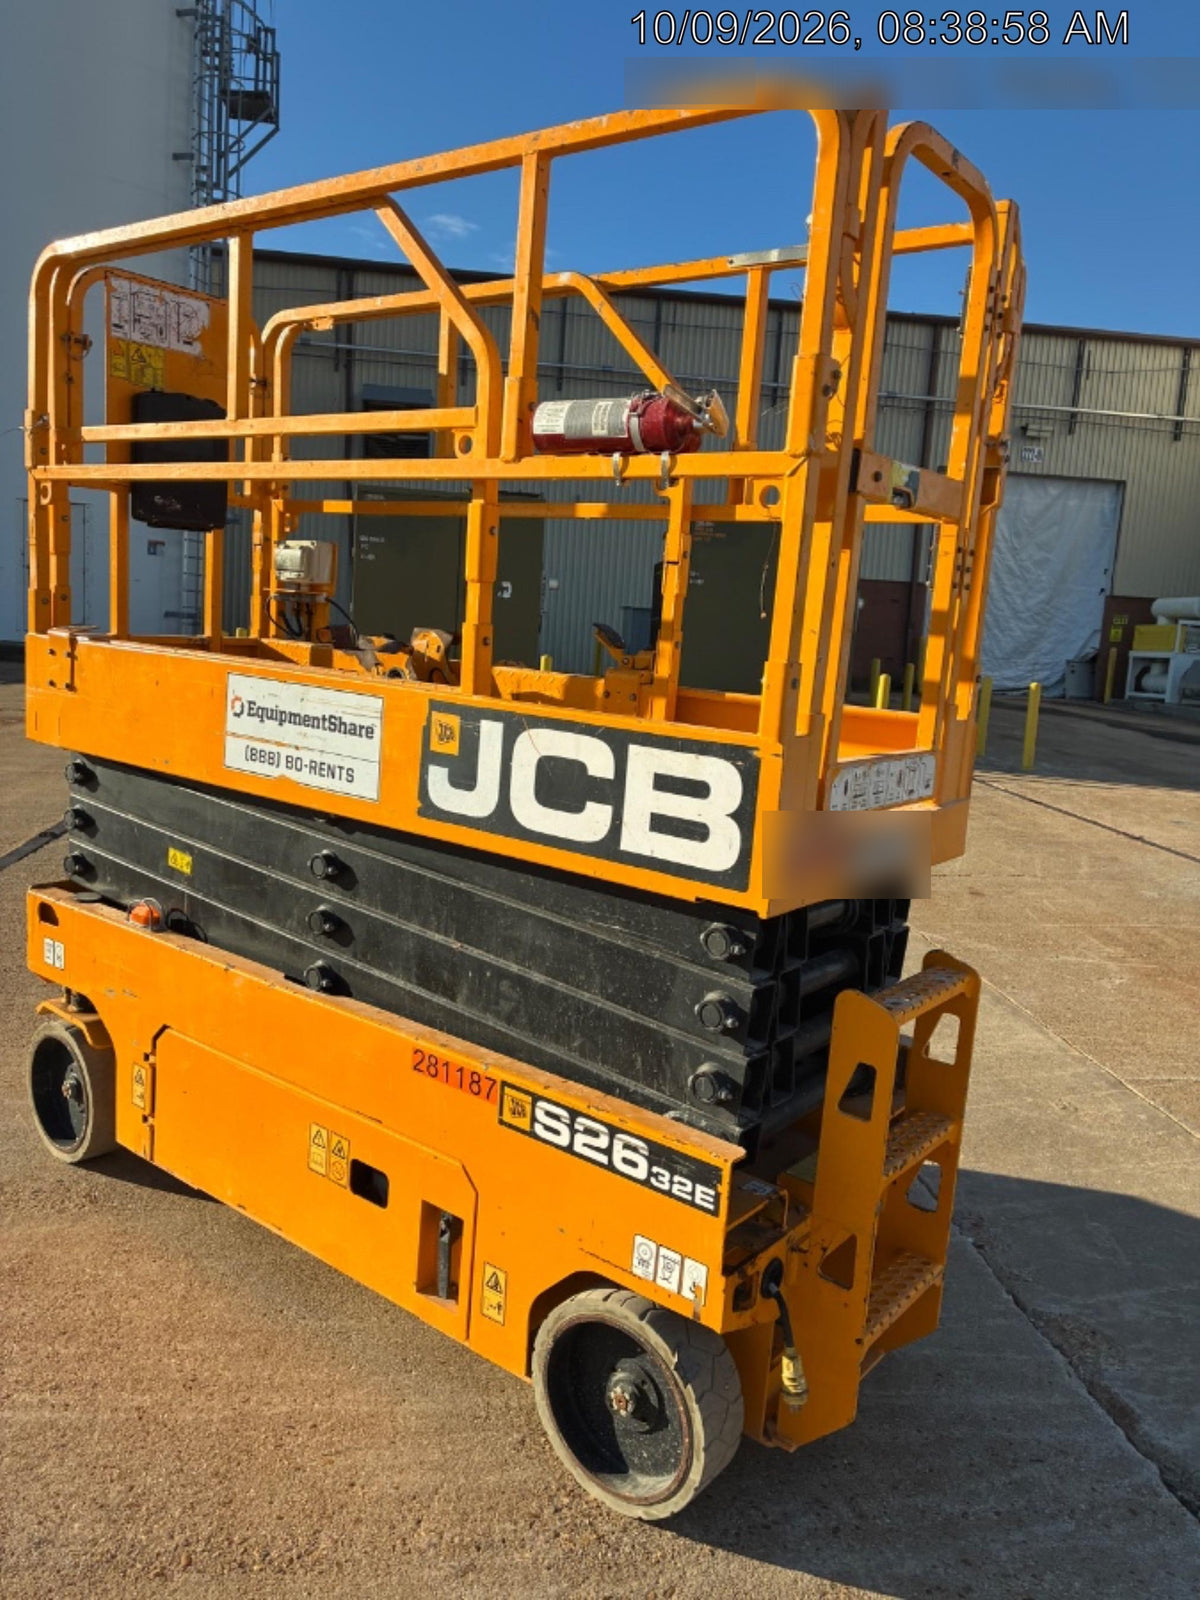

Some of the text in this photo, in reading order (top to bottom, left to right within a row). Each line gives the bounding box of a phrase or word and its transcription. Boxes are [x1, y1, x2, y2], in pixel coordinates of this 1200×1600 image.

[246, 700, 375, 740] EquipmentShare
[427, 719, 744, 872] JCB
[412, 1048, 497, 1101] 281187
